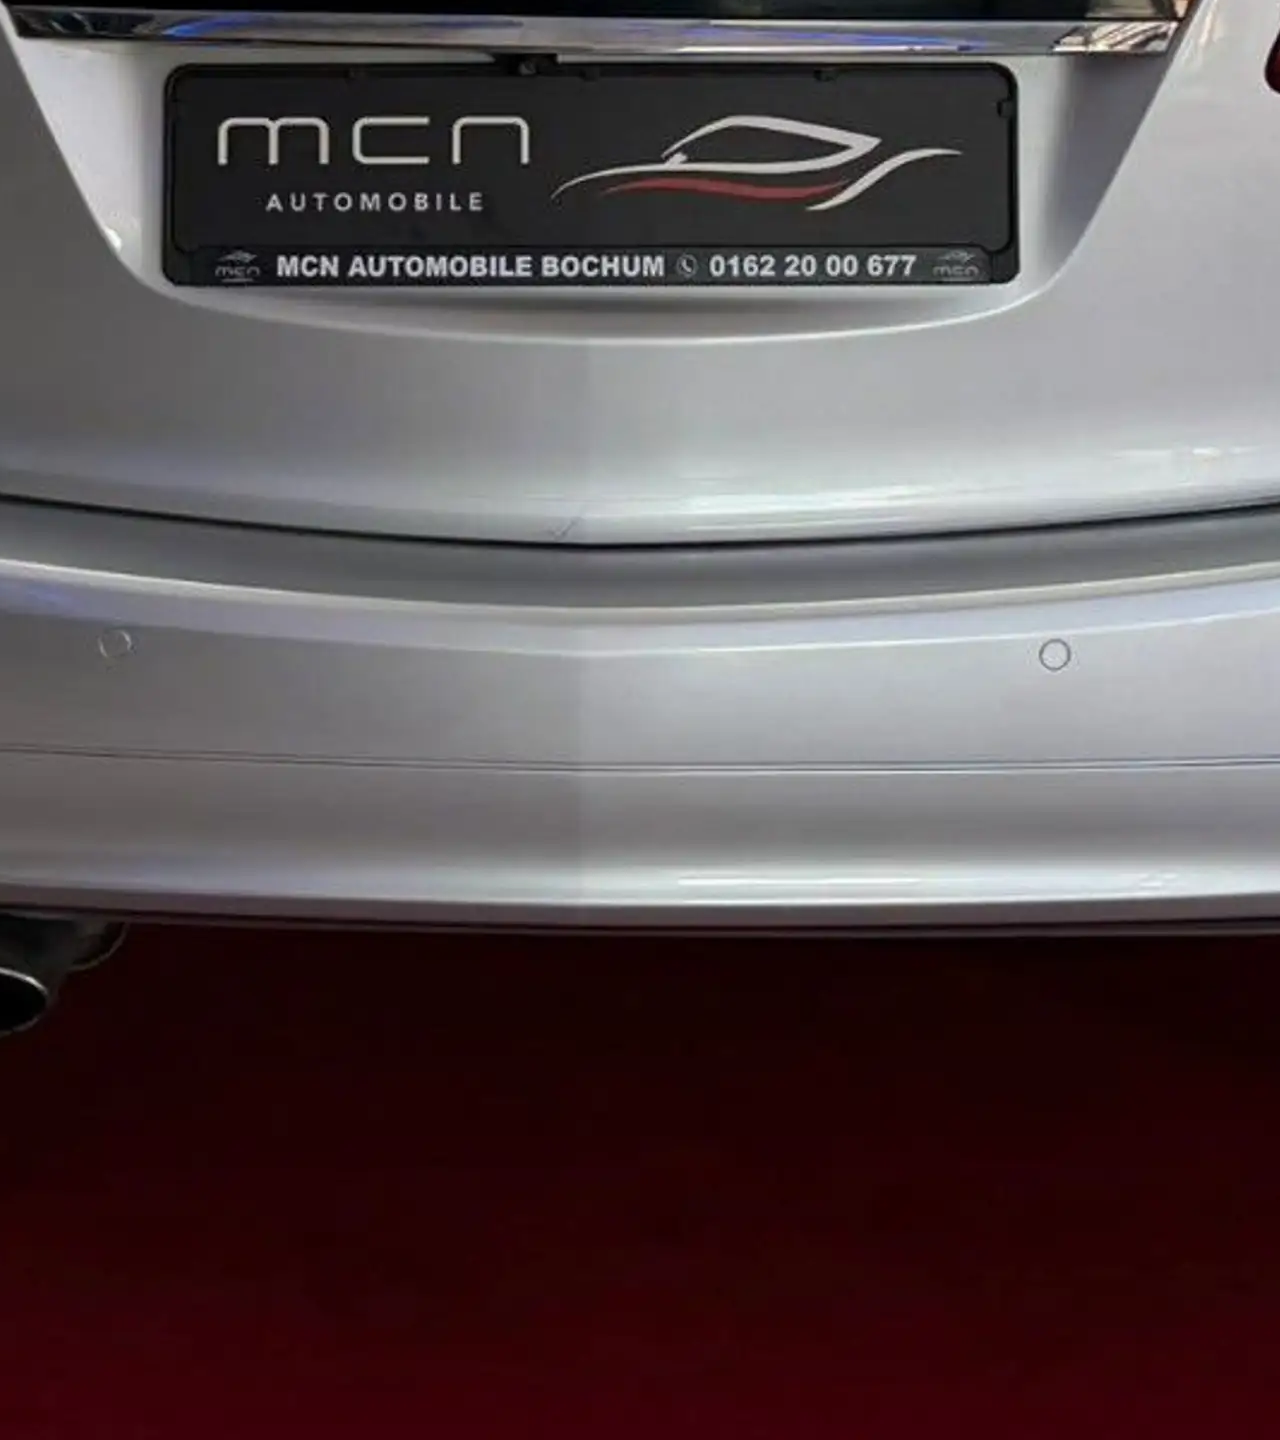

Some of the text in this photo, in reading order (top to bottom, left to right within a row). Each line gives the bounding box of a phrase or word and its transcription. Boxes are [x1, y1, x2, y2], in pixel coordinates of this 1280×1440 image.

[265, 191, 484, 212] AUTOMOBILE
[276, 253, 918, 277] MCN AUTOMOBILE BOCHUM 0162 20 00 677
